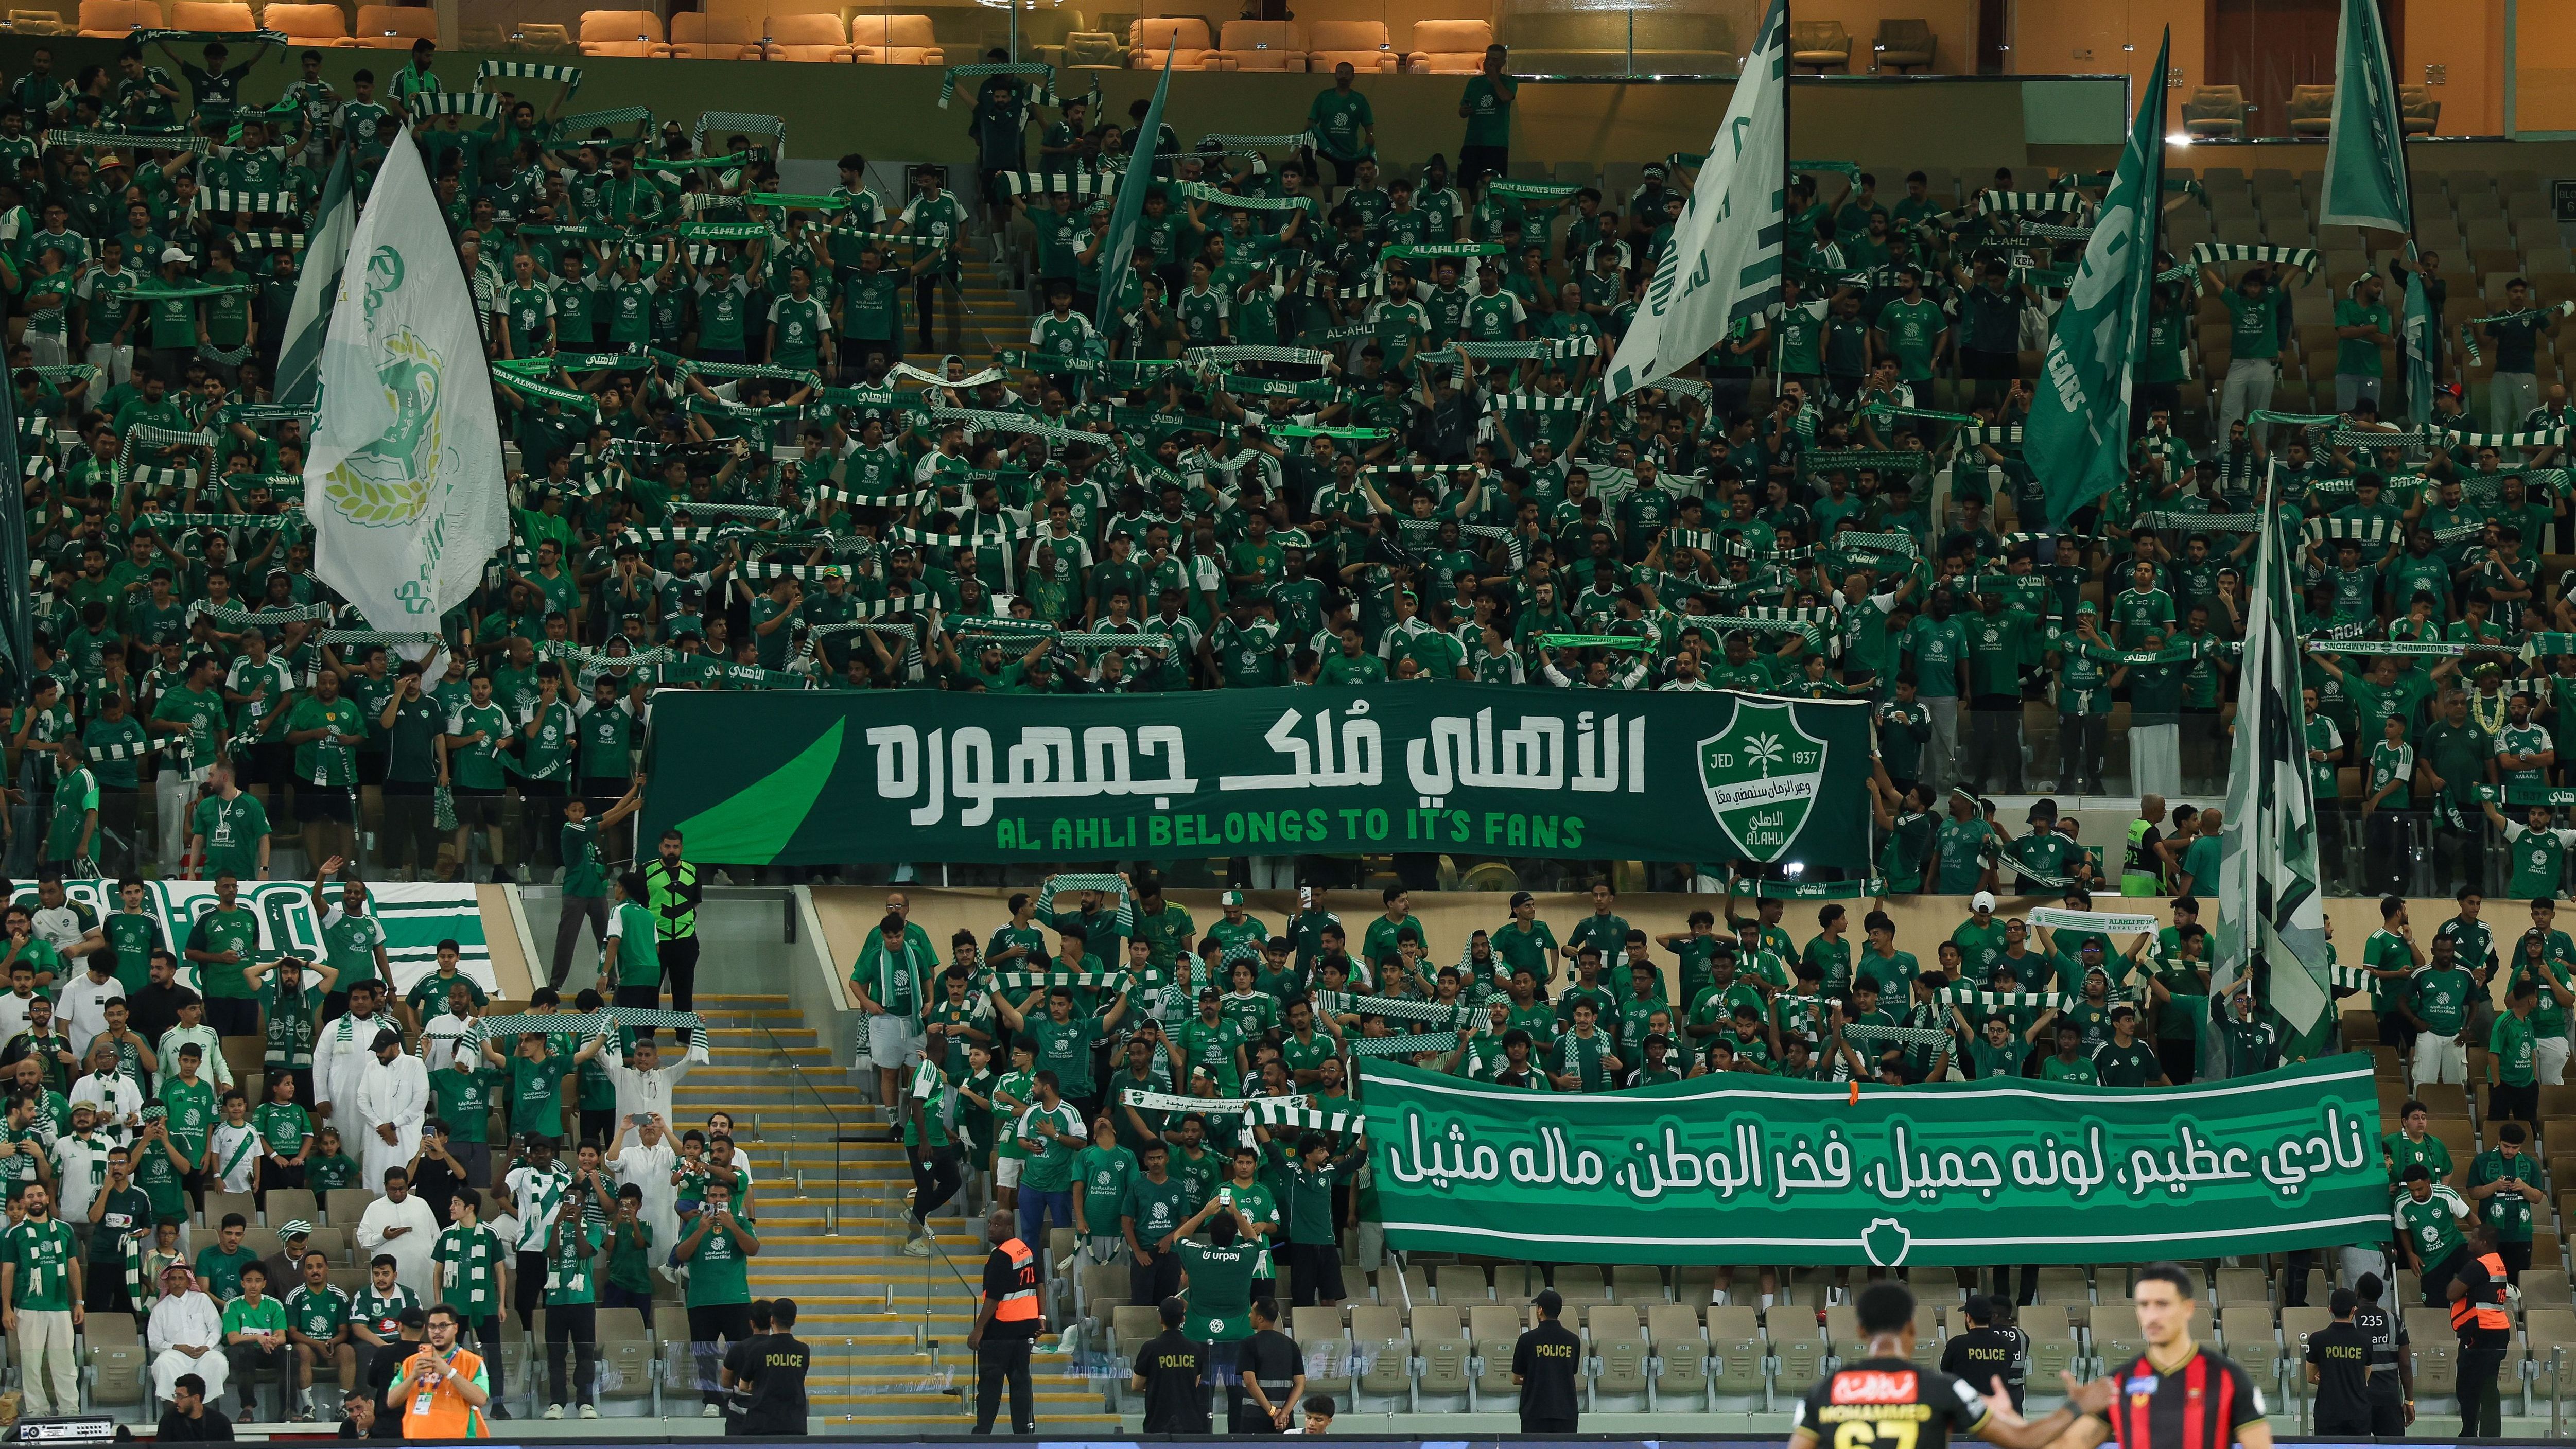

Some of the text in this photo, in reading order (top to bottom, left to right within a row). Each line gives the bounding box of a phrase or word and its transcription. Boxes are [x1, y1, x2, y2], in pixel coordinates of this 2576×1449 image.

[689, 226, 764, 236] ALAHLI FC
[1981, 236, 2029, 246] AL-AHLI
[1409, 244, 1481, 254] ALAHLI FC
[1327, 325, 1375, 338] AL-AHLI
[2047, 333, 2087, 413] YEARS
[857, 392, 892, 404] الأهلي
[2396, 643, 2449, 653] CHAMPIONS
[728, 664, 766, 681] الأهلي
[1407, 707, 1645, 808] الأهلي
[1710, 753, 1734, 769] JED
[1792, 751, 1818, 764] 1937
[866, 725, 1198, 826] جمهوره
[997, 808, 1585, 849] AL AHLI BELONGS TO IT'S FANS
[1391, 1114, 1499, 1188] مثيل
[1510, 1127, 1603, 1185] ماله
[2262, 1109, 2363, 1195] نادي
[1775, 1130, 1851, 1198] فخر
[2012, 1127, 2104, 1196] لونه
[1212, 1251, 1240, 1262] urpay
[2361, 1314, 2383, 1326] 235
[1536, 1344, 1572, 1358] POLICE
[1968, 1348, 2006, 1361] POLICE
[2325, 1346, 2362, 1360] POLICE
[765, 1353, 803, 1368] POLICE
[1158, 1355, 1195, 1369] POLICE
[1833, 1419, 1919, 1449] 67
